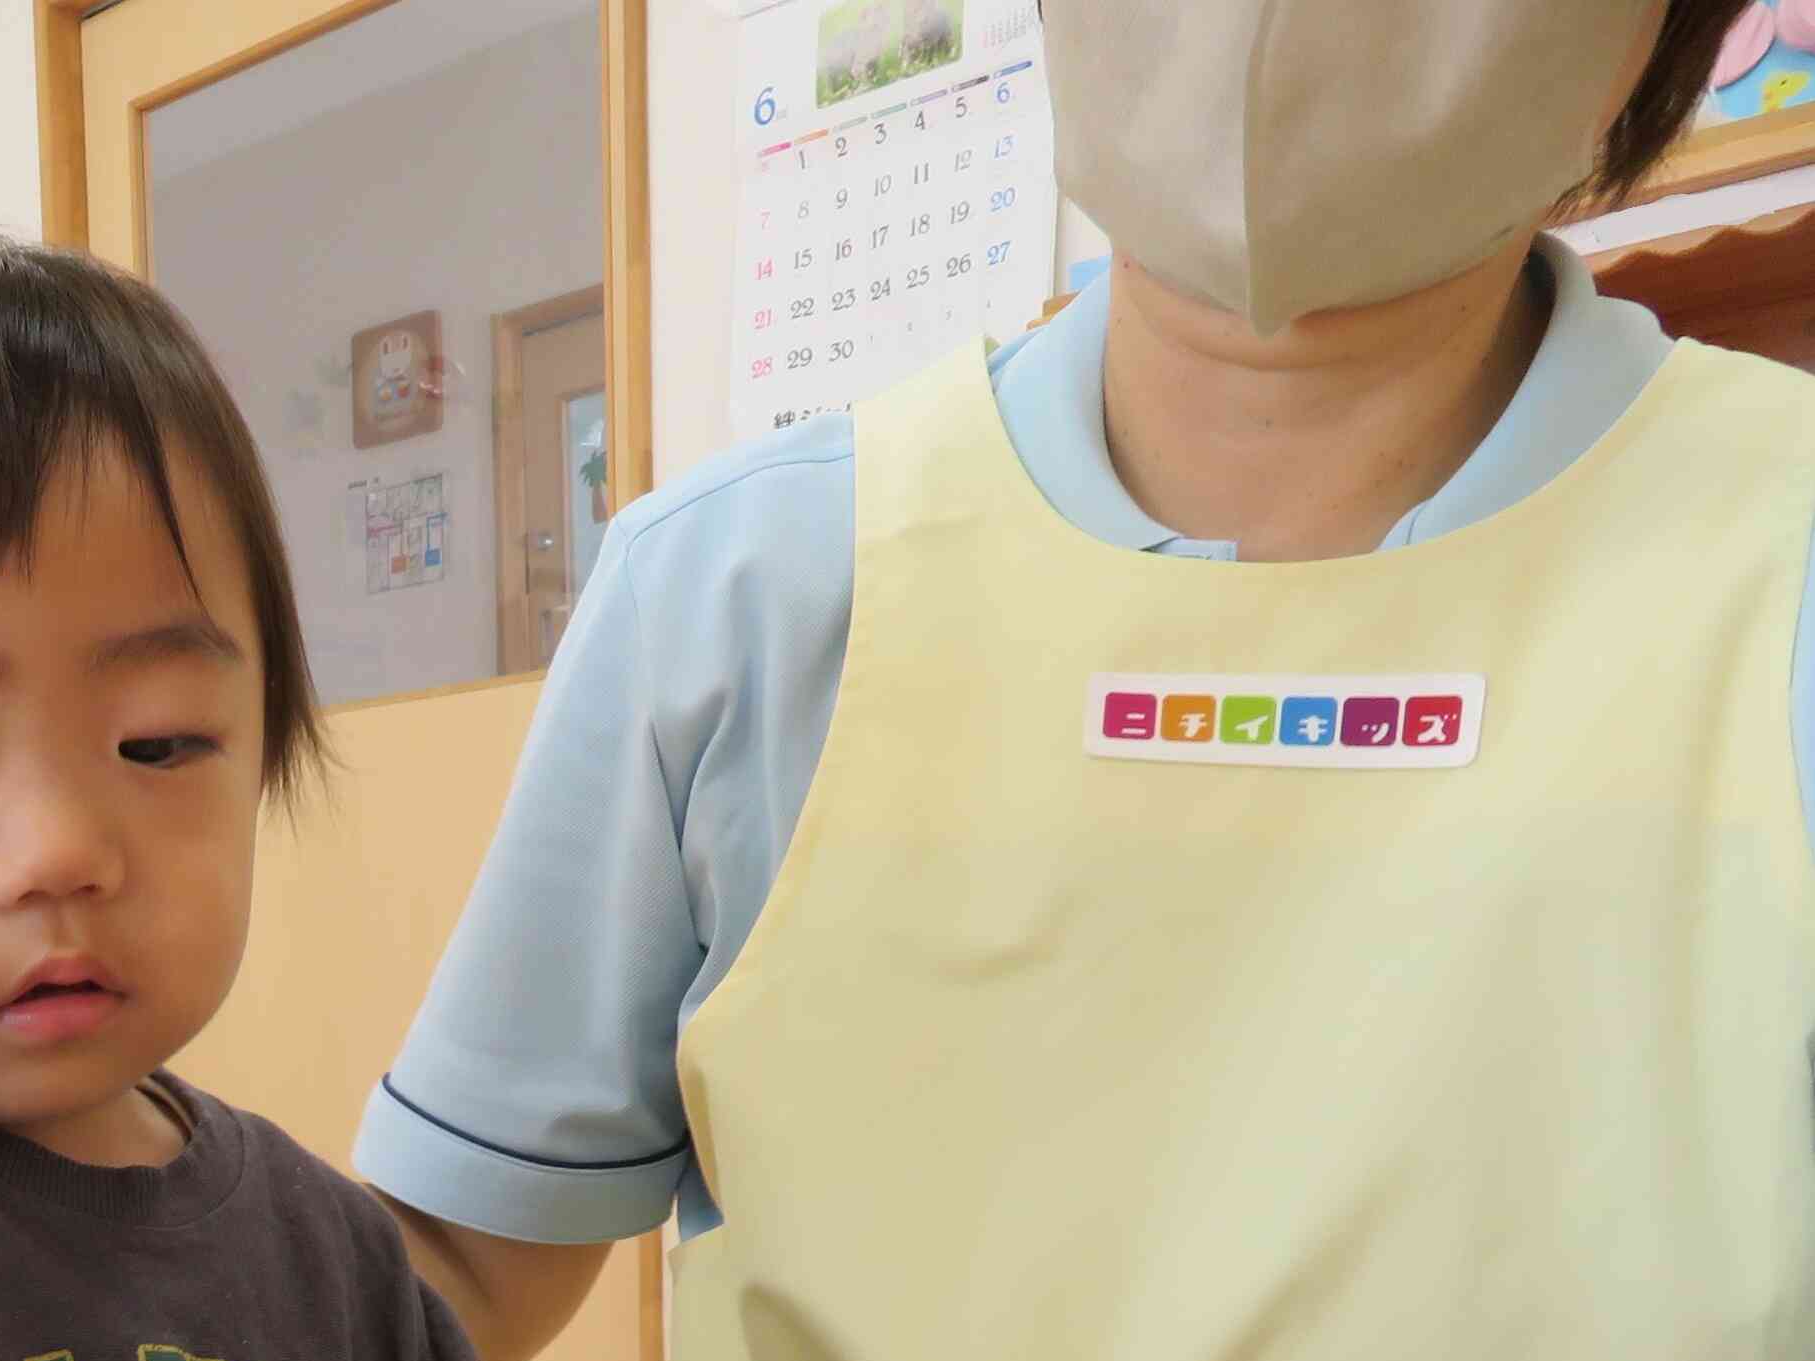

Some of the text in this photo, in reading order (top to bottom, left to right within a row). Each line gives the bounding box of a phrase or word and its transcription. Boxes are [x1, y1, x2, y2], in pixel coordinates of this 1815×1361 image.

[754, 87, 775, 125] 6
[799, 82, 1010, 169] 1 2 3 4 5 6
[798, 201, 809, 219] 8
[836, 189, 847, 209] 9
[874, 175, 891, 197] 10
[914, 163, 929, 184] 11
[994, 136, 1013, 158] 13
[758, 188, 1015, 280] 14 15 16 17 18 19 20
[754, 241, 1010, 329] 21 22 23 24 25 26 27
[788, 348, 812, 369] 29
[829, 340, 854, 362] 30
[1118, 706, 1460, 746] ニチイキッズ
